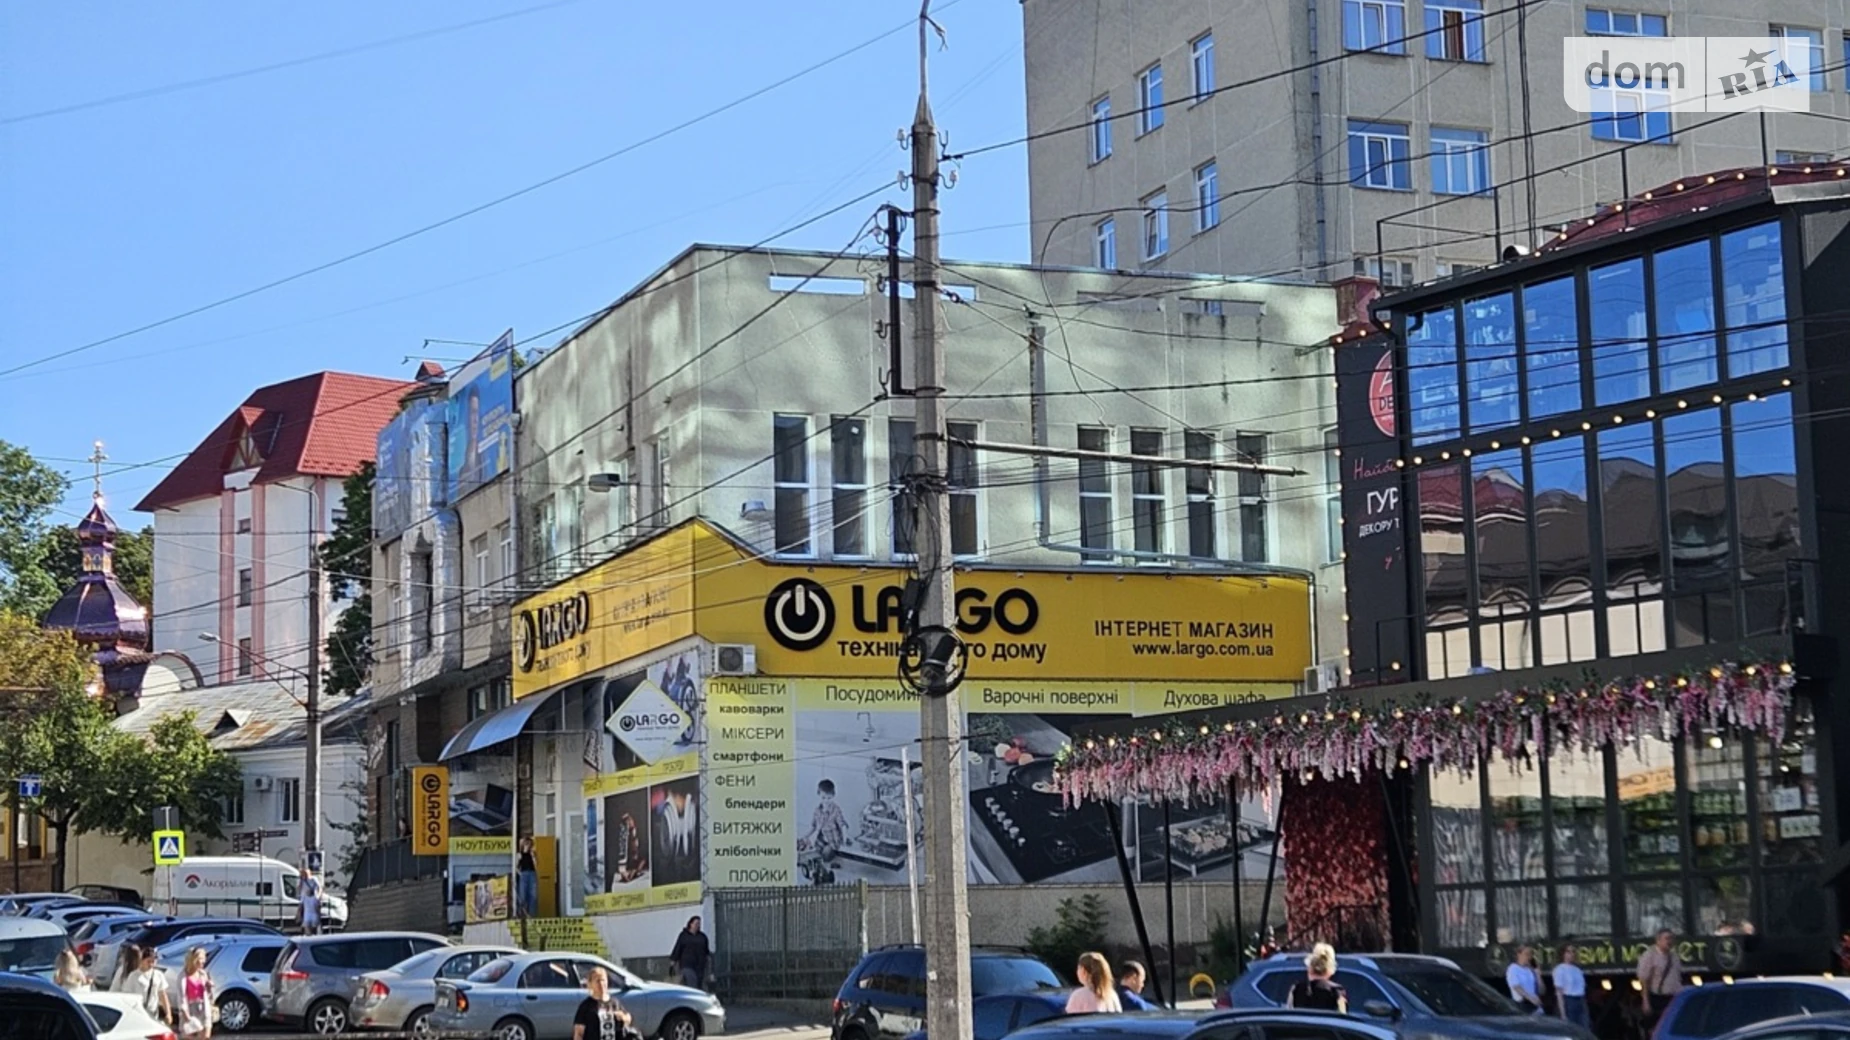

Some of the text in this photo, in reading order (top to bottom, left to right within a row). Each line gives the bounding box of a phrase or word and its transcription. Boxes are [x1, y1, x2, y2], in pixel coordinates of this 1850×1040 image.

[852, 584, 1039, 635] LAGO
[1095, 620, 1274, 639] ІНТЕРНЕТ МАГАЗИН
[991, 644, 1047, 664] дому
[1133, 640, 1274, 658] www.largo.com.ua
[710, 682, 786, 695] ПЛАНШЕТИ
[983, 687, 1119, 708] Варочні поверхні
[1164, 690, 1219, 709] Духова
[719, 705, 784, 717] кавоварки
[636, 713, 681, 726] LARGO
[722, 727, 784, 740] МІКСЕРИ
[713, 751, 784, 764] смартфони
[715, 774, 756, 788] ФЕНИ
[725, 797, 786, 811] блендери
[427, 794, 441, 847] LARGO
[713, 821, 782, 835] ВИТЯЖКИ
[456, 839, 511, 851] НОУТБУКИ
[714, 844, 782, 857] хлібопічки
[729, 867, 788, 883] ПЛОЙКИ
